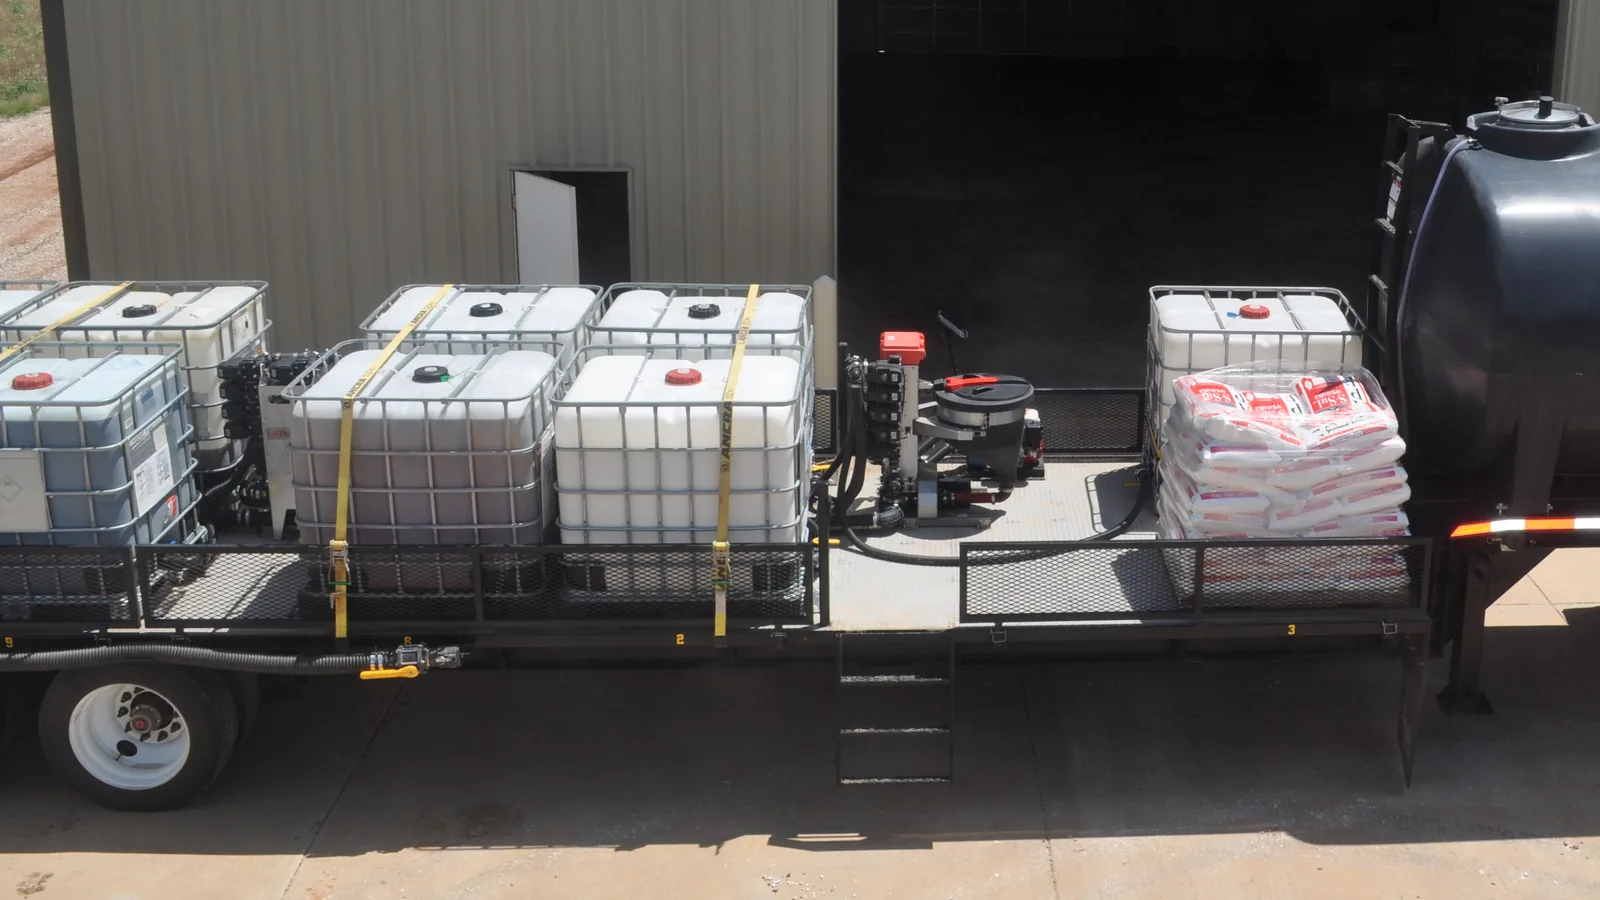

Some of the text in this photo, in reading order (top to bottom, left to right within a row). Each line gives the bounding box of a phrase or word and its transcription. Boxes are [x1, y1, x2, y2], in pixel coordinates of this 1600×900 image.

[721, 401, 732, 460] ANCRA
[1287, 624, 1296, 635] 3
[5, 636, 13, 648] 9
[676, 633, 684, 645] 2
